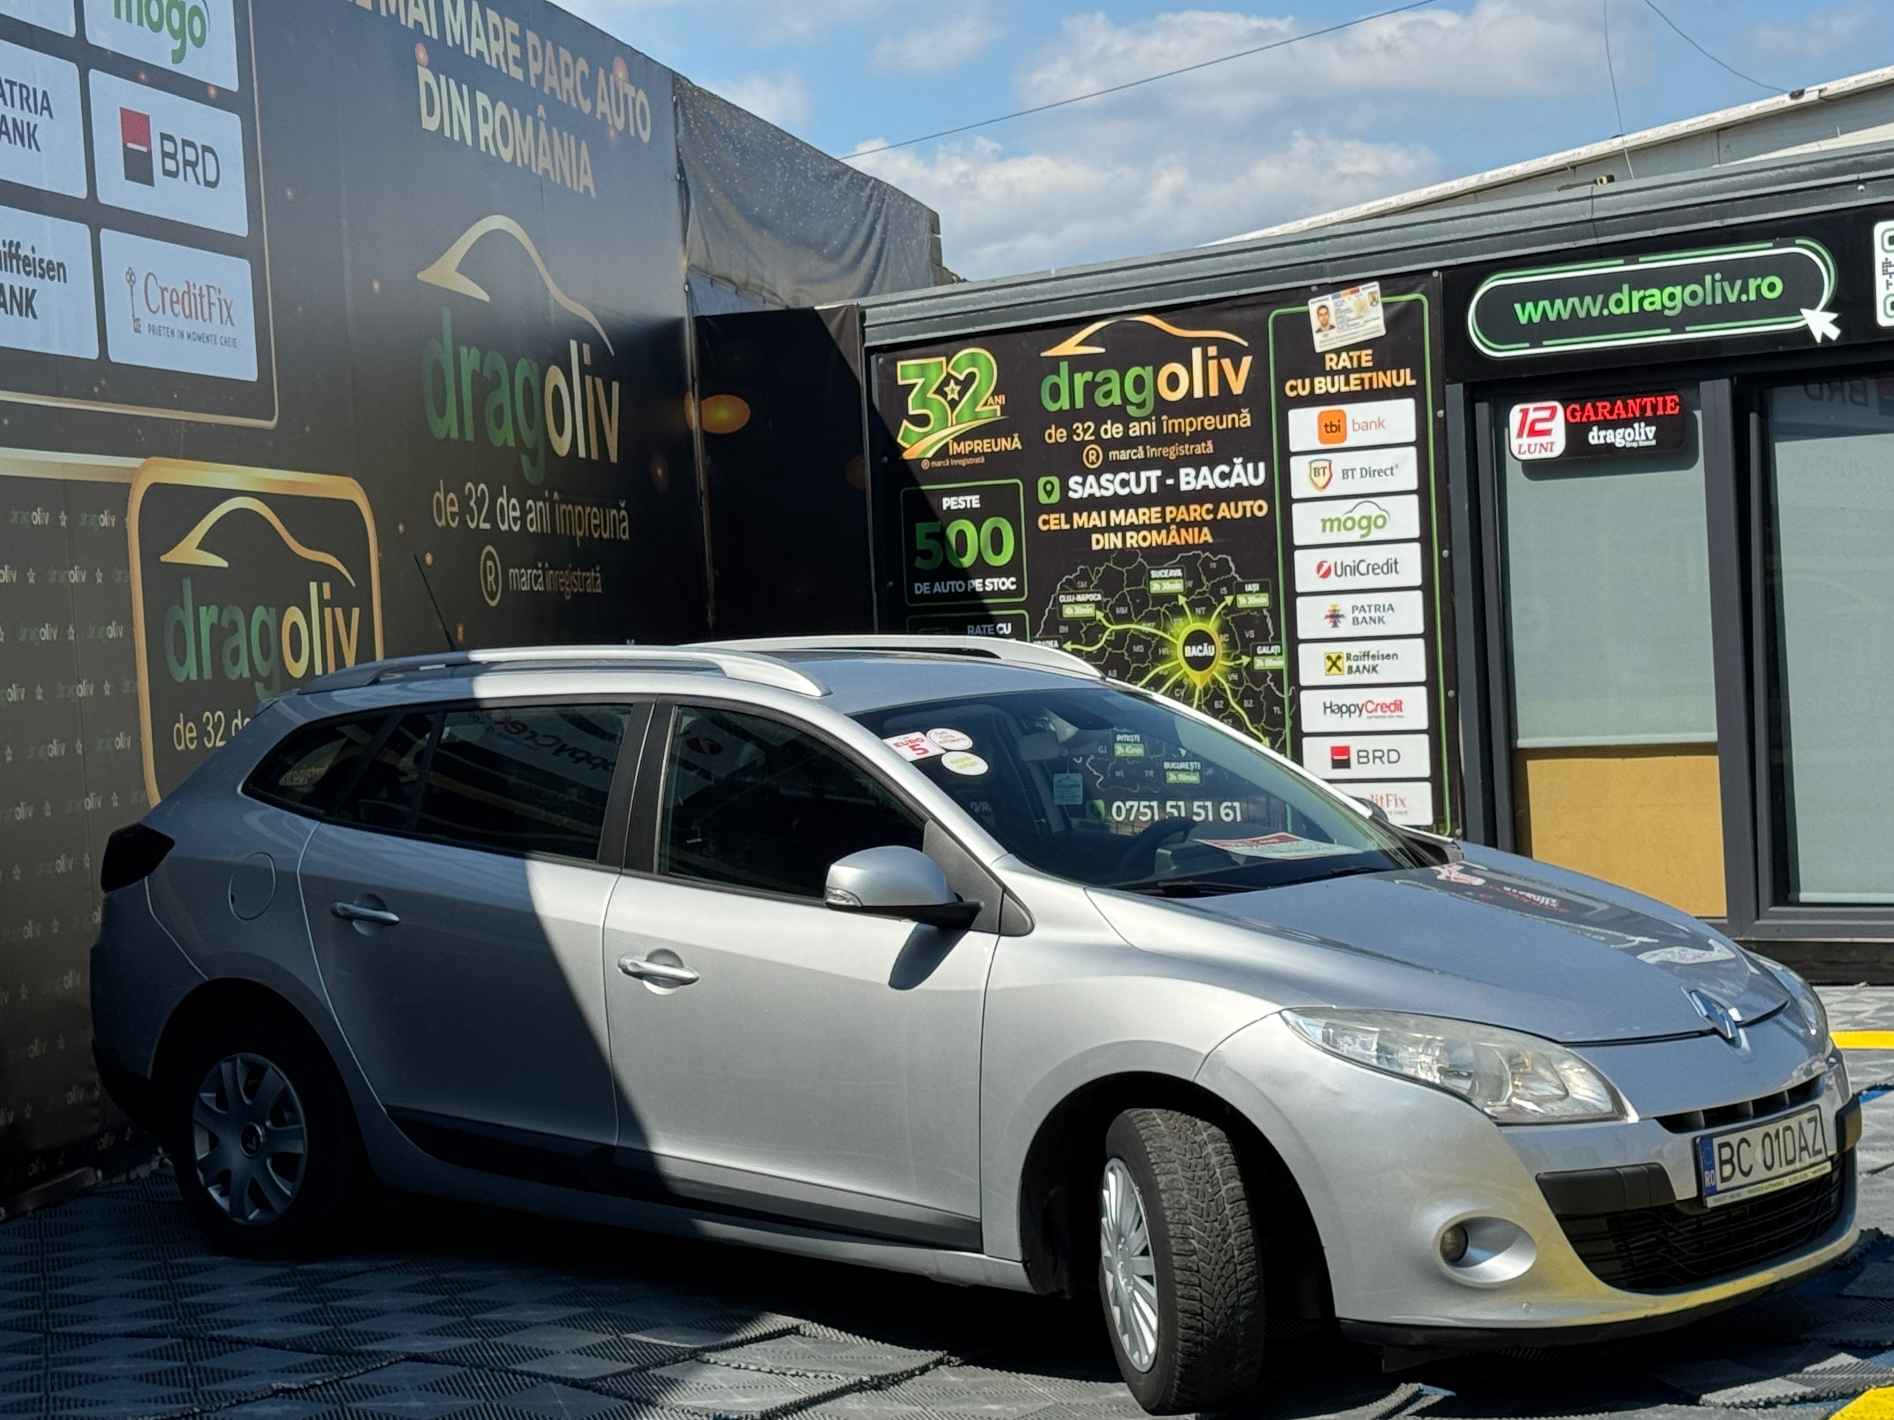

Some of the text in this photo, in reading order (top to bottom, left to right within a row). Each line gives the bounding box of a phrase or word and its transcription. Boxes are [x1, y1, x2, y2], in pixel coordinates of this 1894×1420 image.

[440, 0, 524, 82] MARE
[526, 29, 592, 115] PARC
[595, 66, 652, 144] AUTO
[0, 78, 54, 120] ATRIA
[0, 116, 41, 152] ANK
[417, 64, 596, 199] DIN ROMÂNIA
[159, 132, 221, 189] BRD
[0, 239, 67, 284] iffeisen
[0, 289, 37, 320] ANK
[143, 271, 236, 327] CreditFix
[1514, 273, 1784, 325] www.dragoliv.ro
[1325, 349, 1373, 371] RATE
[1040, 345, 1253, 417] dragoliv
[1285, 368, 1417, 397] CU BULETINUL
[422, 305, 620, 486] dragoliv
[897, 347, 1000, 450] 32
[987, 394, 1006, 407] ANI
[1566, 394, 1681, 423] GARANTIE
[1044, 408, 1251, 443] de 32 de ani împreună
[1323, 417, 1386, 434] tbi bank
[1516, 405, 1558, 439] 12
[1588, 422, 1657, 447] dragoliv
[948, 433, 1023, 456] ÎMPREUNĂ
[1108, 446, 1144, 461] marcă
[1146, 440, 1214, 460] înregistrată
[1517, 441, 1556, 456] LUNI
[1068, 470, 1161, 499] SASCUT
[1179, 457, 1266, 491] BACĂU
[1313, 465, 1328, 478] BT
[1341, 468, 1357, 480] BT
[433, 480, 630, 547] de 32 de ani împreună
[942, 495, 981, 510] PESTE
[1037, 499, 1268, 531] CEL MAI MARE PARC AUTO
[1091, 525, 1213, 550] DIN ROMÂNIA
[1320, 513, 1387, 539] mogo
[914, 516, 1015, 570] 500
[508, 562, 544, 592] marcă
[545, 563, 603, 600] înregistrată
[1334, 558, 1400, 578] UniCredit
[914, 576, 1017, 595] DE AUTO PE STOC
[1351, 604, 1395, 614] PATRIA
[1352, 615, 1386, 626] BANK
[164, 578, 360, 702] dragoliv
[967, 622, 1012, 636] RATE CU
[1184, 643, 1215, 657] BACĂU
[1346, 651, 1399, 663] Raiffeisen
[1347, 664, 1379, 675] BANK
[1323, 699, 1404, 718] HappyCredit
[173, 713, 198, 751] de
[203, 711, 227, 748] 32
[909, 743, 930, 756] 5
[1357, 749, 1401, 765] BRD
[1111, 800, 1242, 823] 0751 51 51 61
[1717, 1137, 1754, 1184] BC
[1762, 1115, 1823, 1172] 01DAZ
[1704, 1169, 1716, 1187] RO
